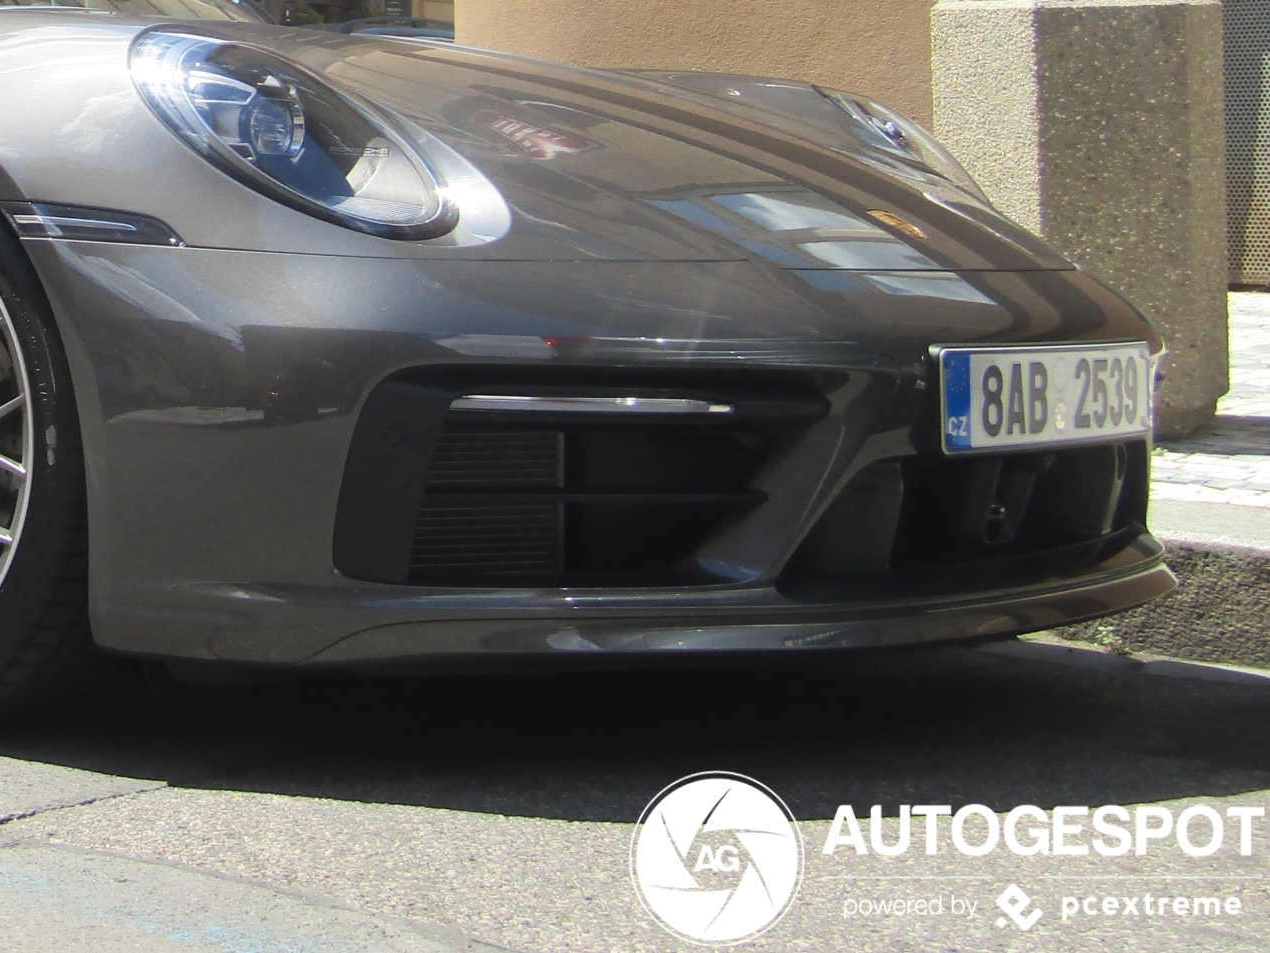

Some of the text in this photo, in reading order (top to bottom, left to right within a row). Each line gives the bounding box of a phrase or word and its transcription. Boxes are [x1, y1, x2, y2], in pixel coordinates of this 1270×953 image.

[982, 356, 1138, 437] 8AB 2539
[948, 416, 968, 436] CZ
